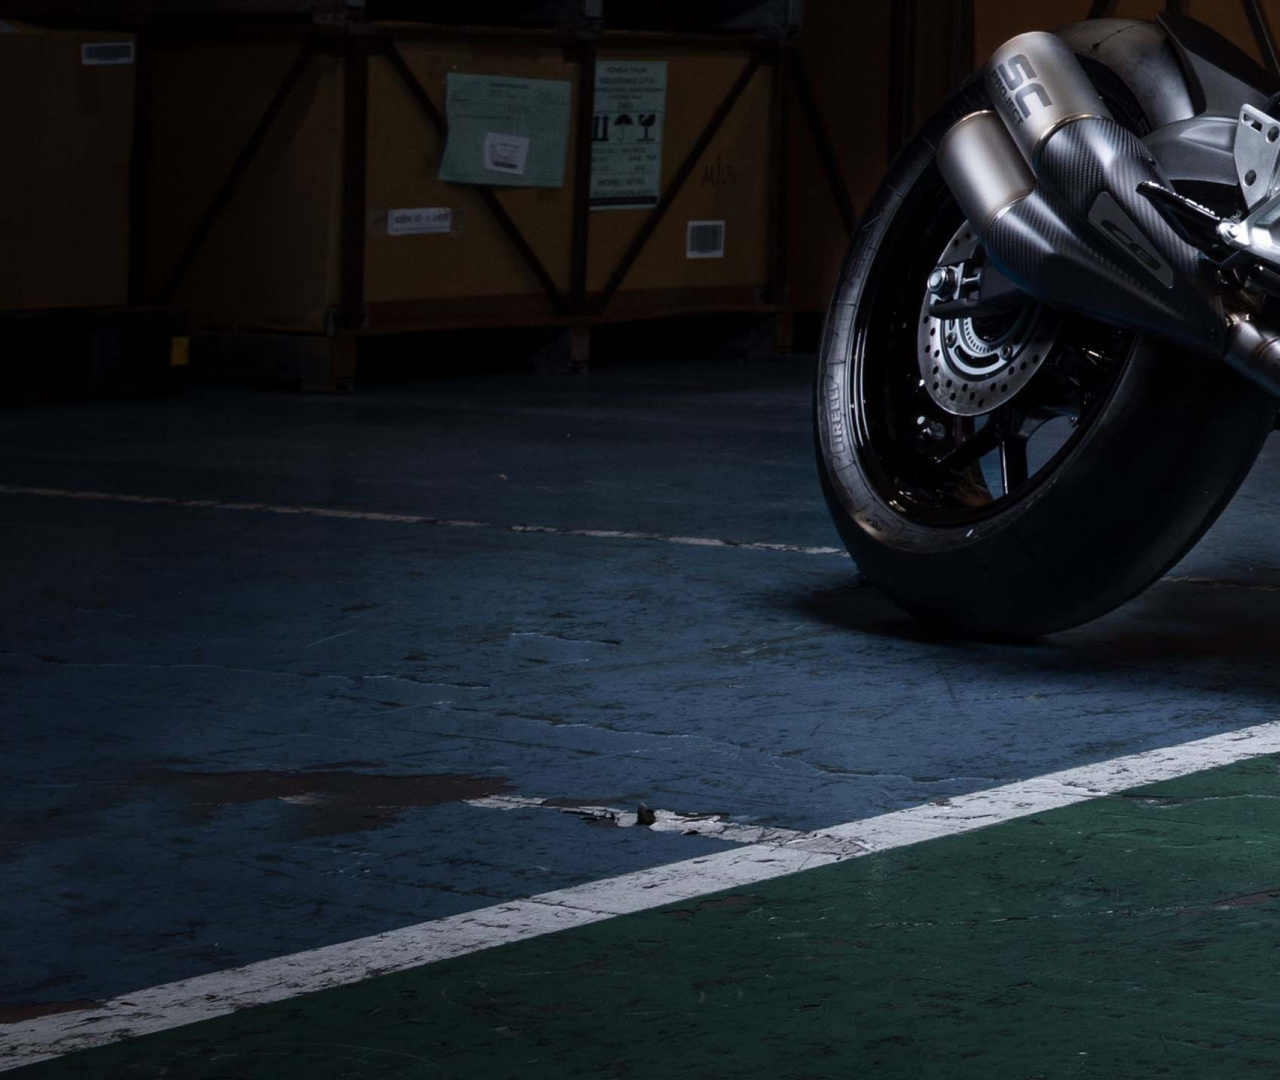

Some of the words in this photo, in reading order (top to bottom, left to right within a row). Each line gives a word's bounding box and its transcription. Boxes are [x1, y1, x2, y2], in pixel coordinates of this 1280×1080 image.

[991, 69, 1024, 126] PROJECT
[997, 54, 1053, 119] SC
[1101, 219, 1161, 270] CB
